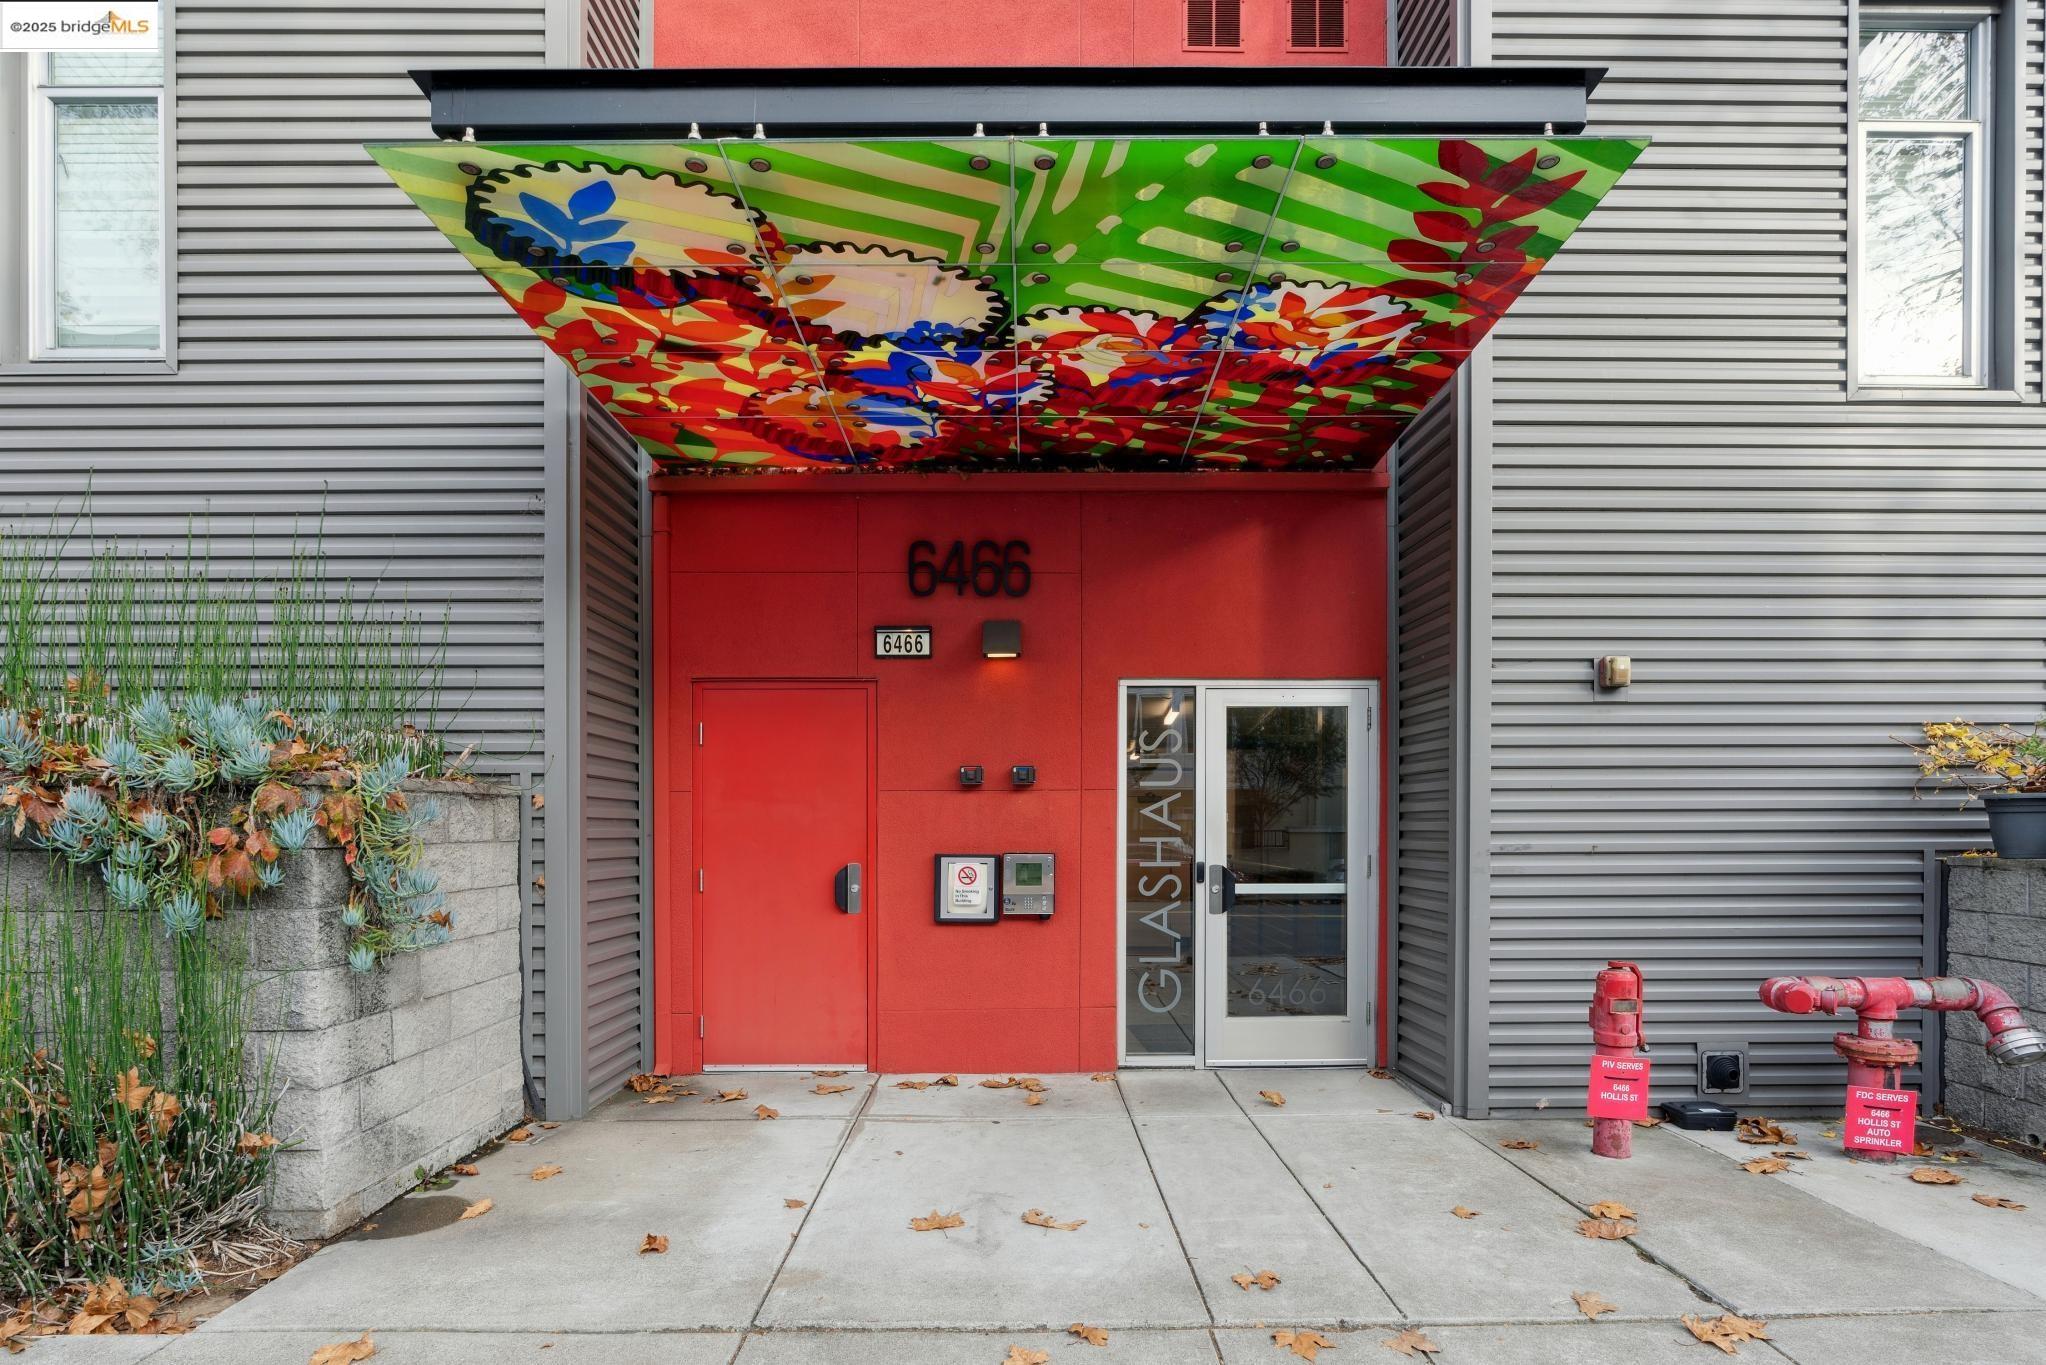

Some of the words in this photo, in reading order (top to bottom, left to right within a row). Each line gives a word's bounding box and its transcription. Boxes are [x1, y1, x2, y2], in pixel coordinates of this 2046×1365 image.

[908, 540, 1031, 597] 6466
[883, 634, 924, 654] 6466
[1138, 729, 1183, 1014] GLASHAUS
[1249, 977, 1326, 1006] 6466
[1602, 1060, 1615, 1069] PIV
[1616, 1061, 1644, 1071] SERVES
[1613, 1083, 1630, 1092] 6466
[1600, 1091, 1629, 1101] HOLLIS
[1629, 1094, 1639, 1102] ST
[1855, 1090, 1874, 1100] FDC
[1875, 1092, 1909, 1103] SERVES
[1871, 1109, 1890, 1118] 6466
[1857, 1117, 1889, 1128] HOLLIS
[1890, 1120, 1901, 1129] ST
[1867, 1127, 1891, 1137] AUTO
[1854, 1135, 1902, 1148] SPRINKLER
